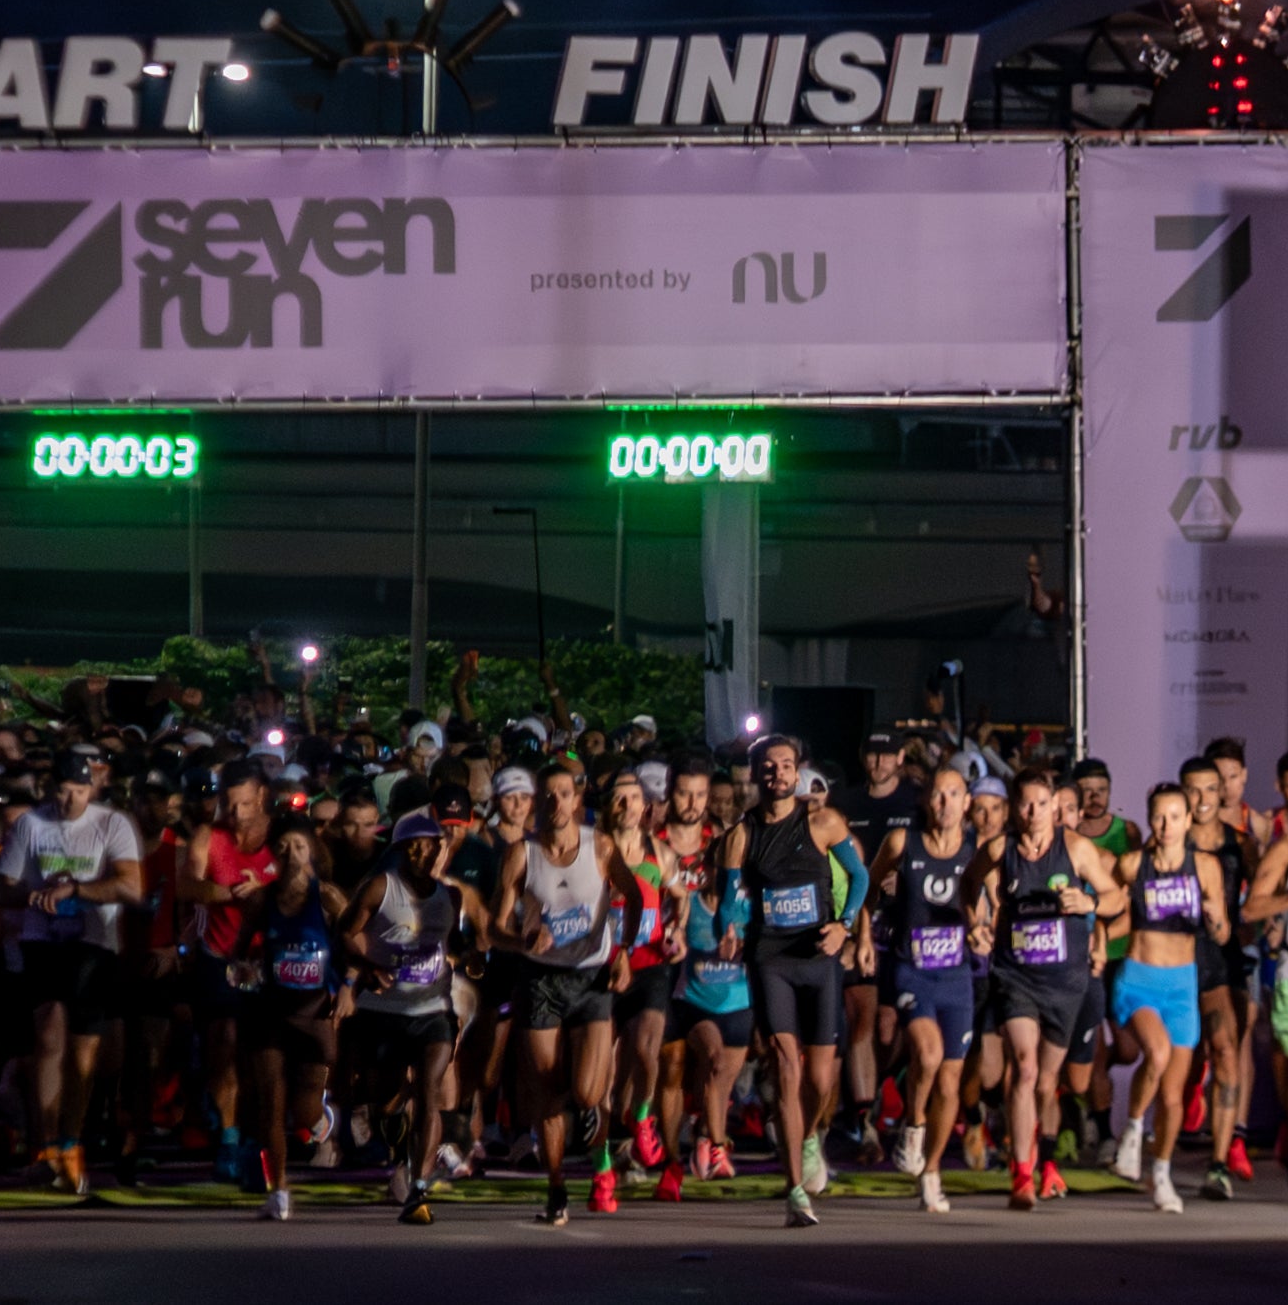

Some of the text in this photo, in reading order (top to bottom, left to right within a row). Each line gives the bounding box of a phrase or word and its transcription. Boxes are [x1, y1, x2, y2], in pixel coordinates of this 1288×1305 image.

[553, 32, 980, 126] FINISH
[134, 196, 456, 278] seven
[530, 269, 691, 292] presented by
[731, 251, 828, 304] nu
[138, 273, 323, 349] run
[1167, 415, 1243, 451] rvb
[774, 897, 810, 915] 4055
